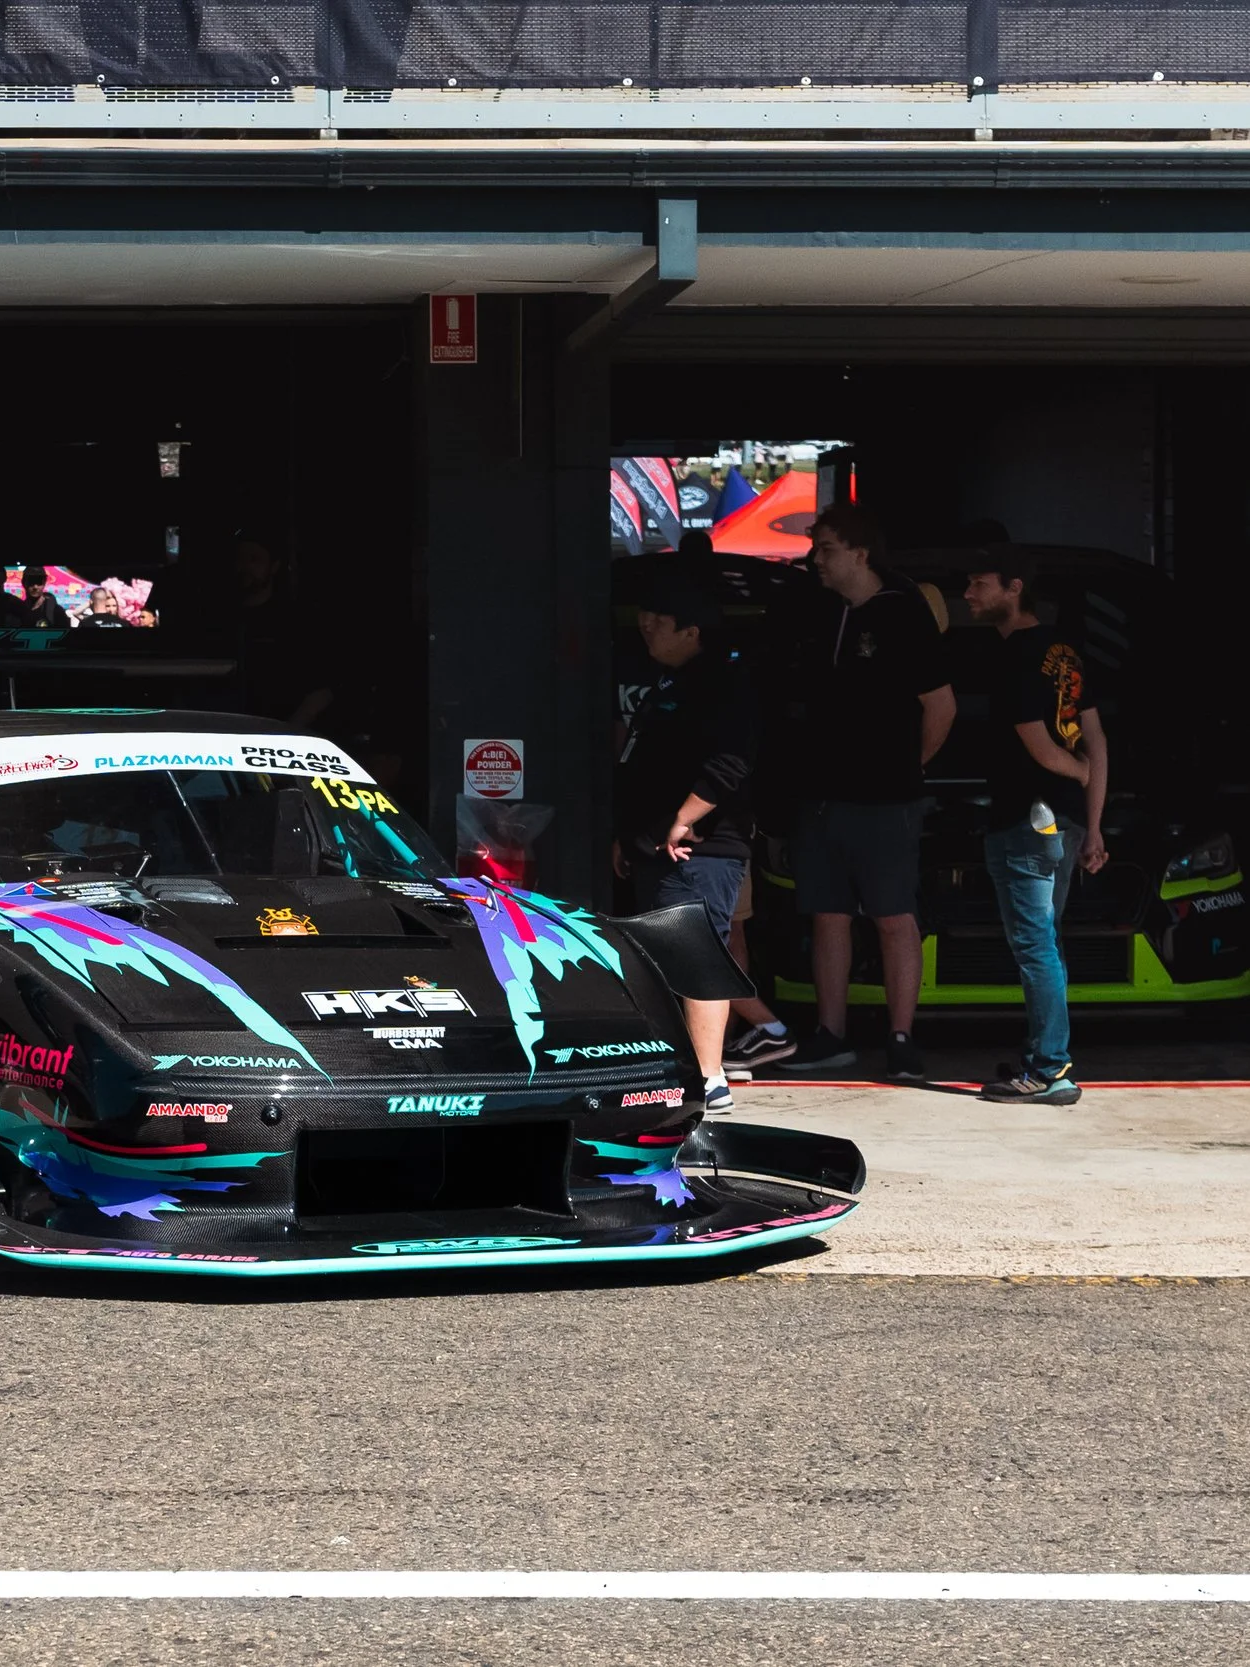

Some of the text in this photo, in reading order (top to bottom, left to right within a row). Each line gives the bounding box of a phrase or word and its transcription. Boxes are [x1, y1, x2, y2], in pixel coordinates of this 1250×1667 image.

[95, 755, 234, 769] PLAZMAMAN
[241, 746, 342, 764] PRO-AM
[245, 757, 351, 776] CLASS
[477, 761, 512, 769] POWDER
[1192, 892, 1246, 914] YOKOHAMA
[302, 989, 477, 1020] HKS
[363, 1027, 446, 1039] TURBOSMART
[388, 1038, 443, 1049] CMA
[575, 1040, 675, 1059] YOKOHAMA
[187, 1055, 302, 1069] YOKOHAMA
[387, 1094, 487, 1114] TANUKI
[621, 1089, 682, 1108] AMAANDO
[146, 1103, 228, 1117] AMAANDO
[439, 1109, 480, 1117] MOTORS
[117, 1249, 259, 1262] AUTO GARAGE
